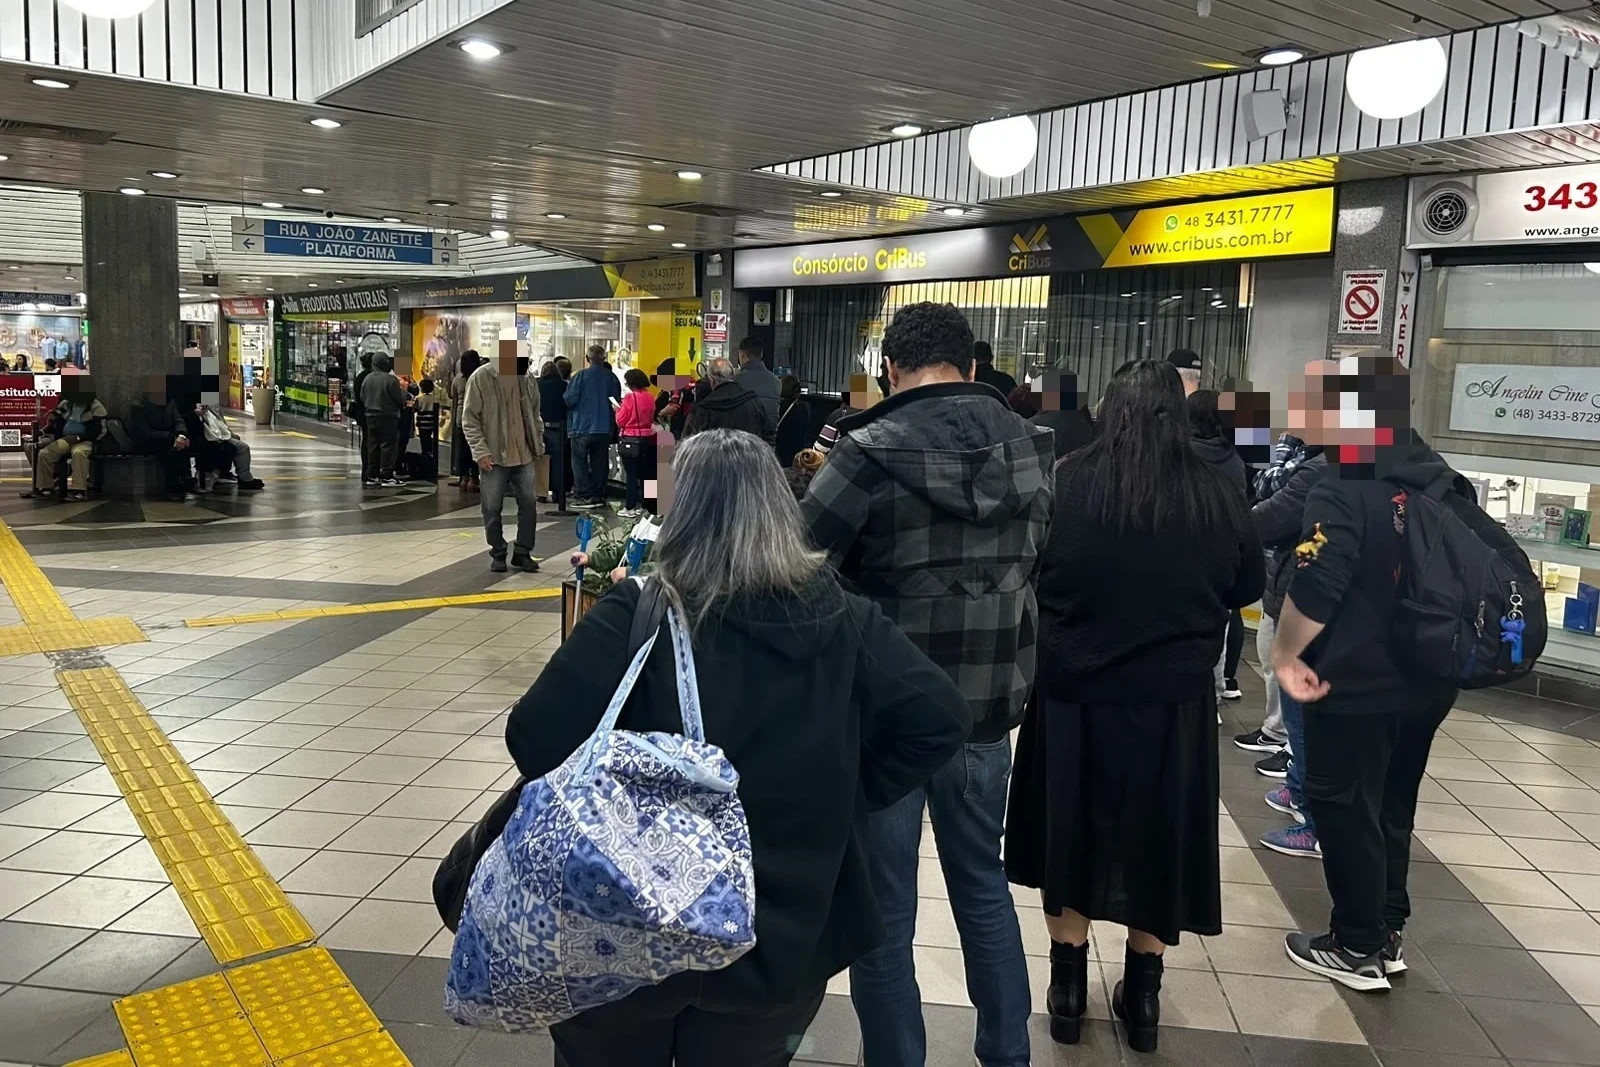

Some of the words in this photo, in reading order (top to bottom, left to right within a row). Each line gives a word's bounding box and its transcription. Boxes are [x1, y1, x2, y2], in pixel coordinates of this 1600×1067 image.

[1523, 182, 1598, 212] 343
[1184, 216, 1200, 227] 48
[1204, 204, 1294, 228] 3431.7777
[279, 223, 309, 237] RUA
[316, 224, 355, 241] JOÃO
[362, 230, 422, 246] ZANETTE
[1129, 228, 1293, 256] www.cribus.com.br
[1524, 226, 1599, 237] www.ange
[305, 241, 396, 260] PLATAFORMA
[792, 253, 868, 275] Consórcio
[875, 248, 926, 272] CriBus
[1008, 253, 1051, 271] CriBus
[301, 294, 341, 313] PRODUTOS
[344, 290, 389, 308] NATURAIS
[675, 317, 688, 327] SEU
[1465, 374, 1543, 404] Angelin
[1548, 384, 1589, 402] Cine
[1512, 408, 1534, 420] (48)
[1537, 409, 1600, 423] 3433-8729
